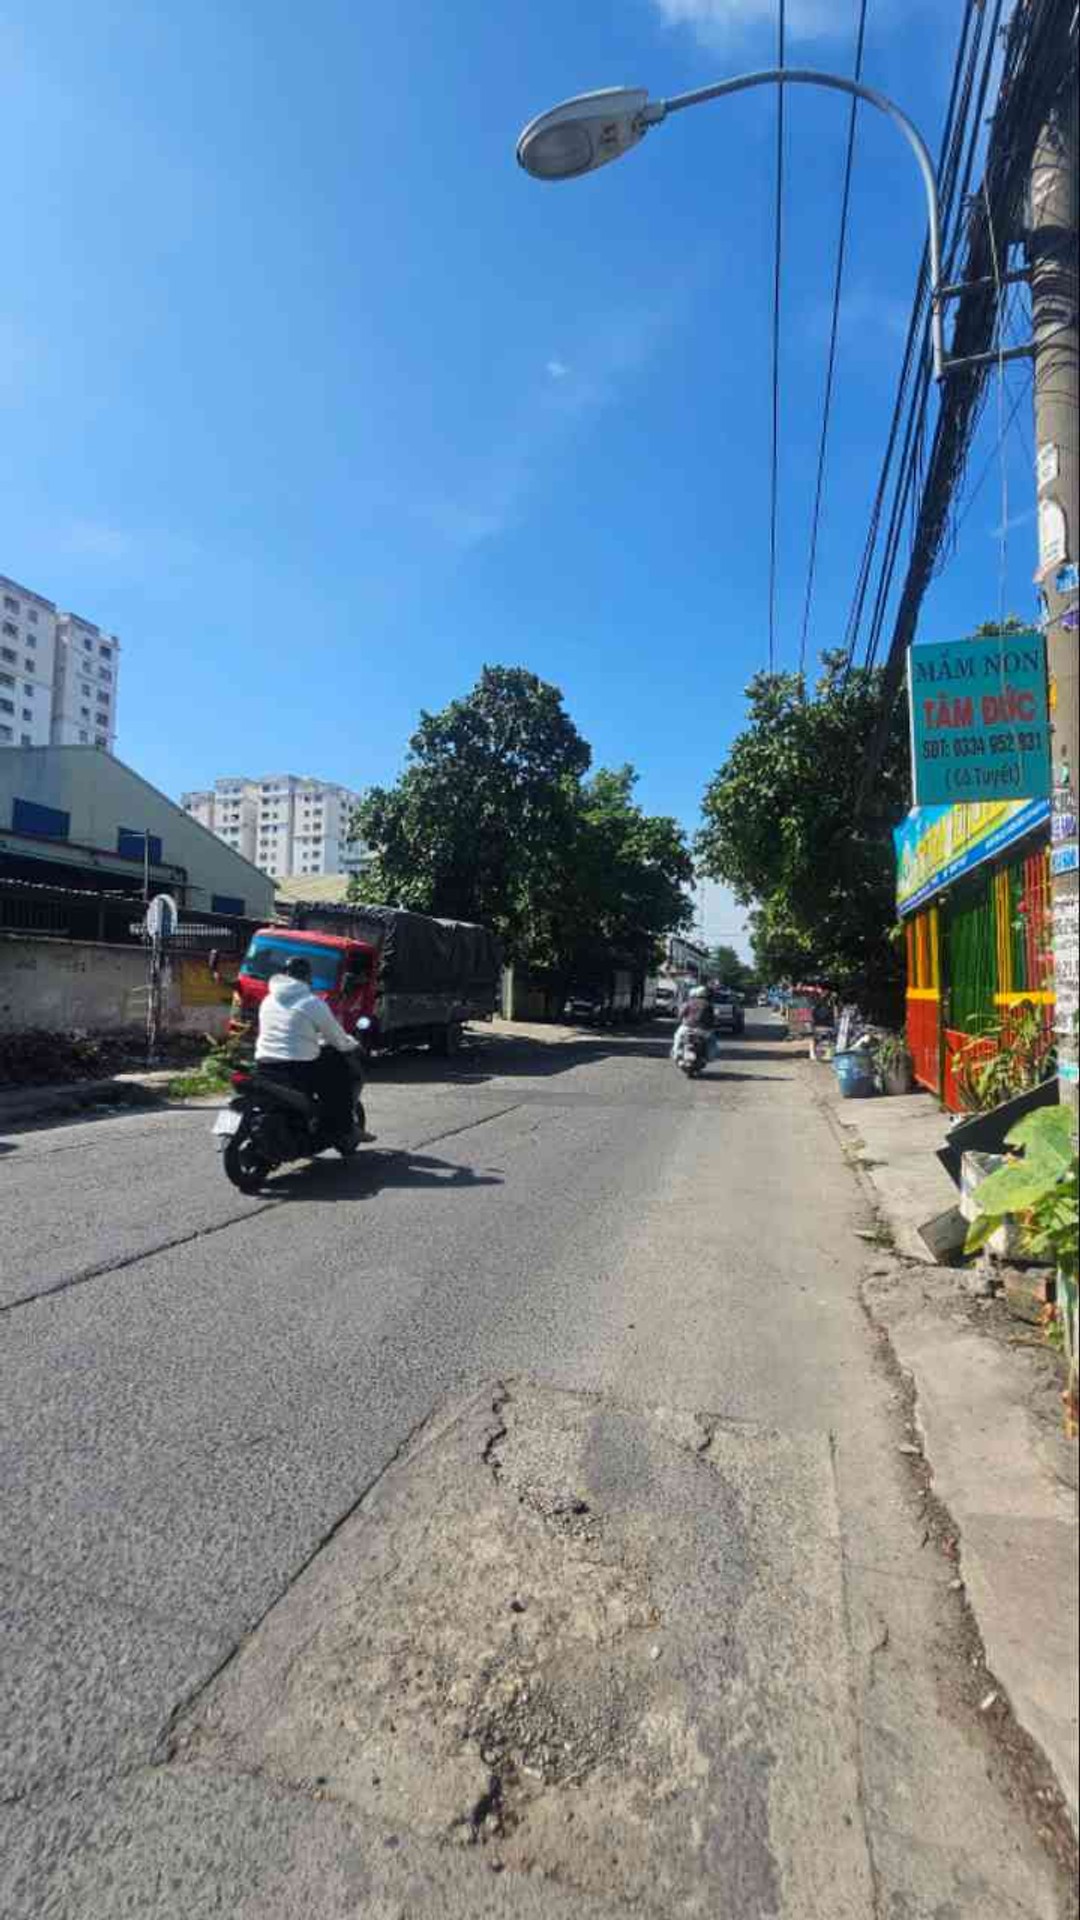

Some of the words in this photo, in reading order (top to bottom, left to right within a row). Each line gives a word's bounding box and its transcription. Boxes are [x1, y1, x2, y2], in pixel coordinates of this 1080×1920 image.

[983, 649, 1039, 677] NON
[923, 690, 973, 729] TÂM
[981, 684, 1035, 726] ĐỨC
